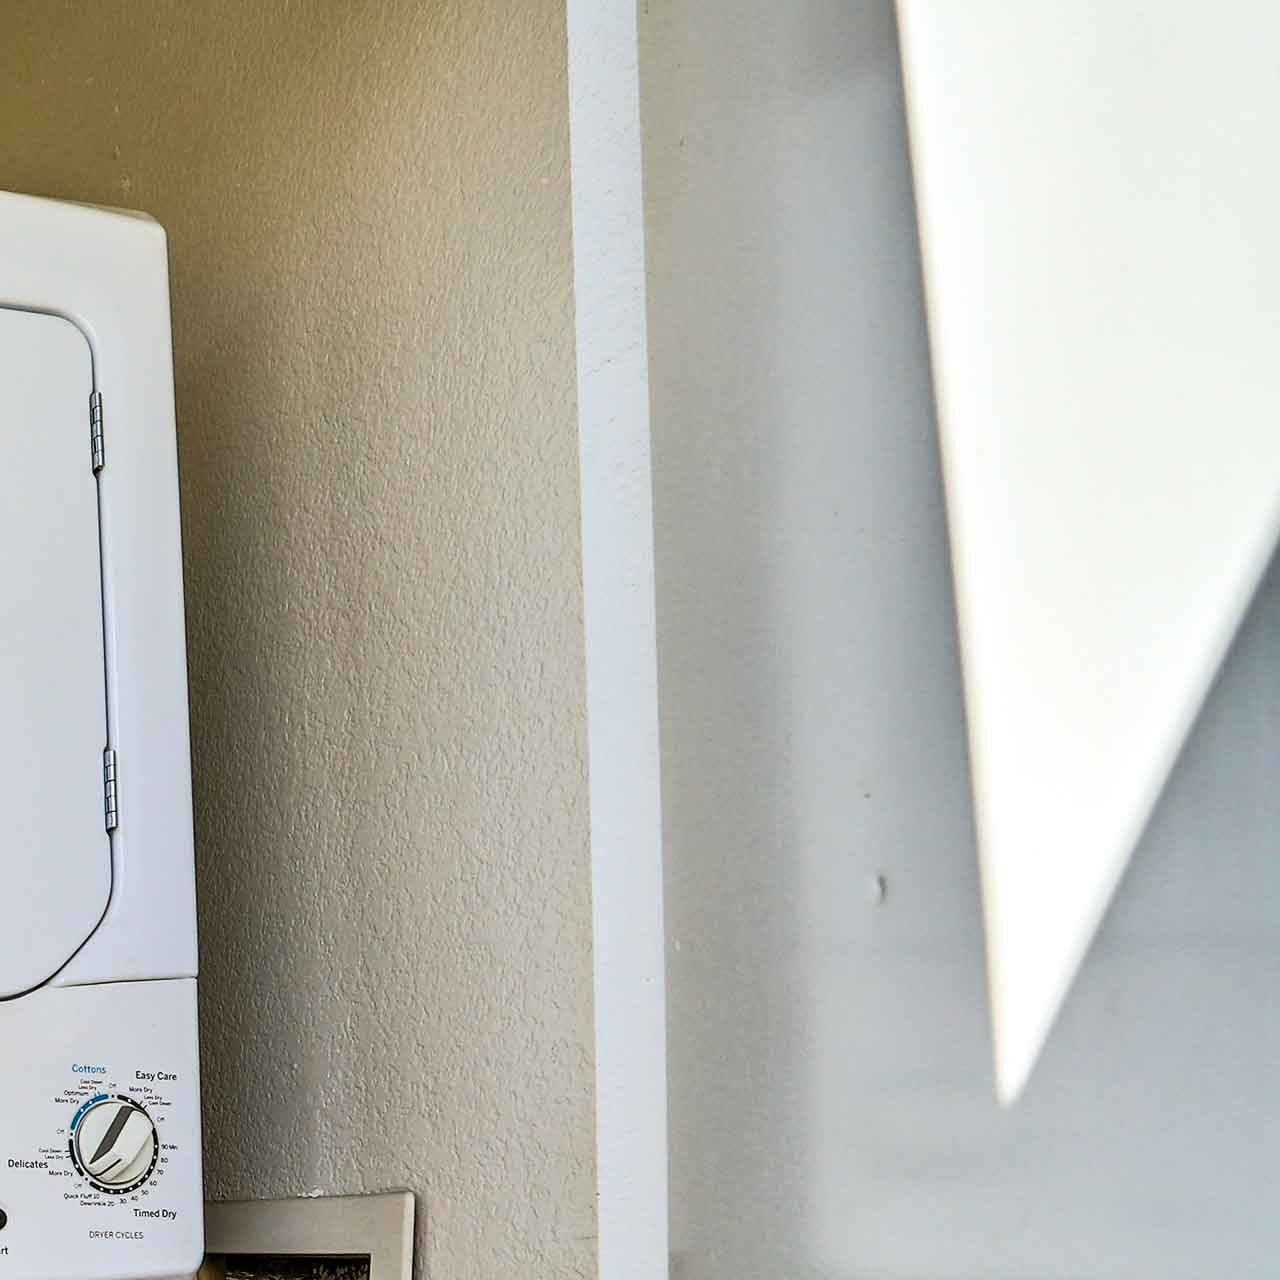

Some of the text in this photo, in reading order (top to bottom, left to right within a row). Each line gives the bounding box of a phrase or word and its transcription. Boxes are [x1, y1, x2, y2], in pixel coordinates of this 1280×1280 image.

[72, 1064, 106, 1073] Cottons
[136, 1071, 176, 1081] Easy Care
[8, 1160, 48, 1168] Delicates
[134, 1209, 176, 1219] Timed Dry
